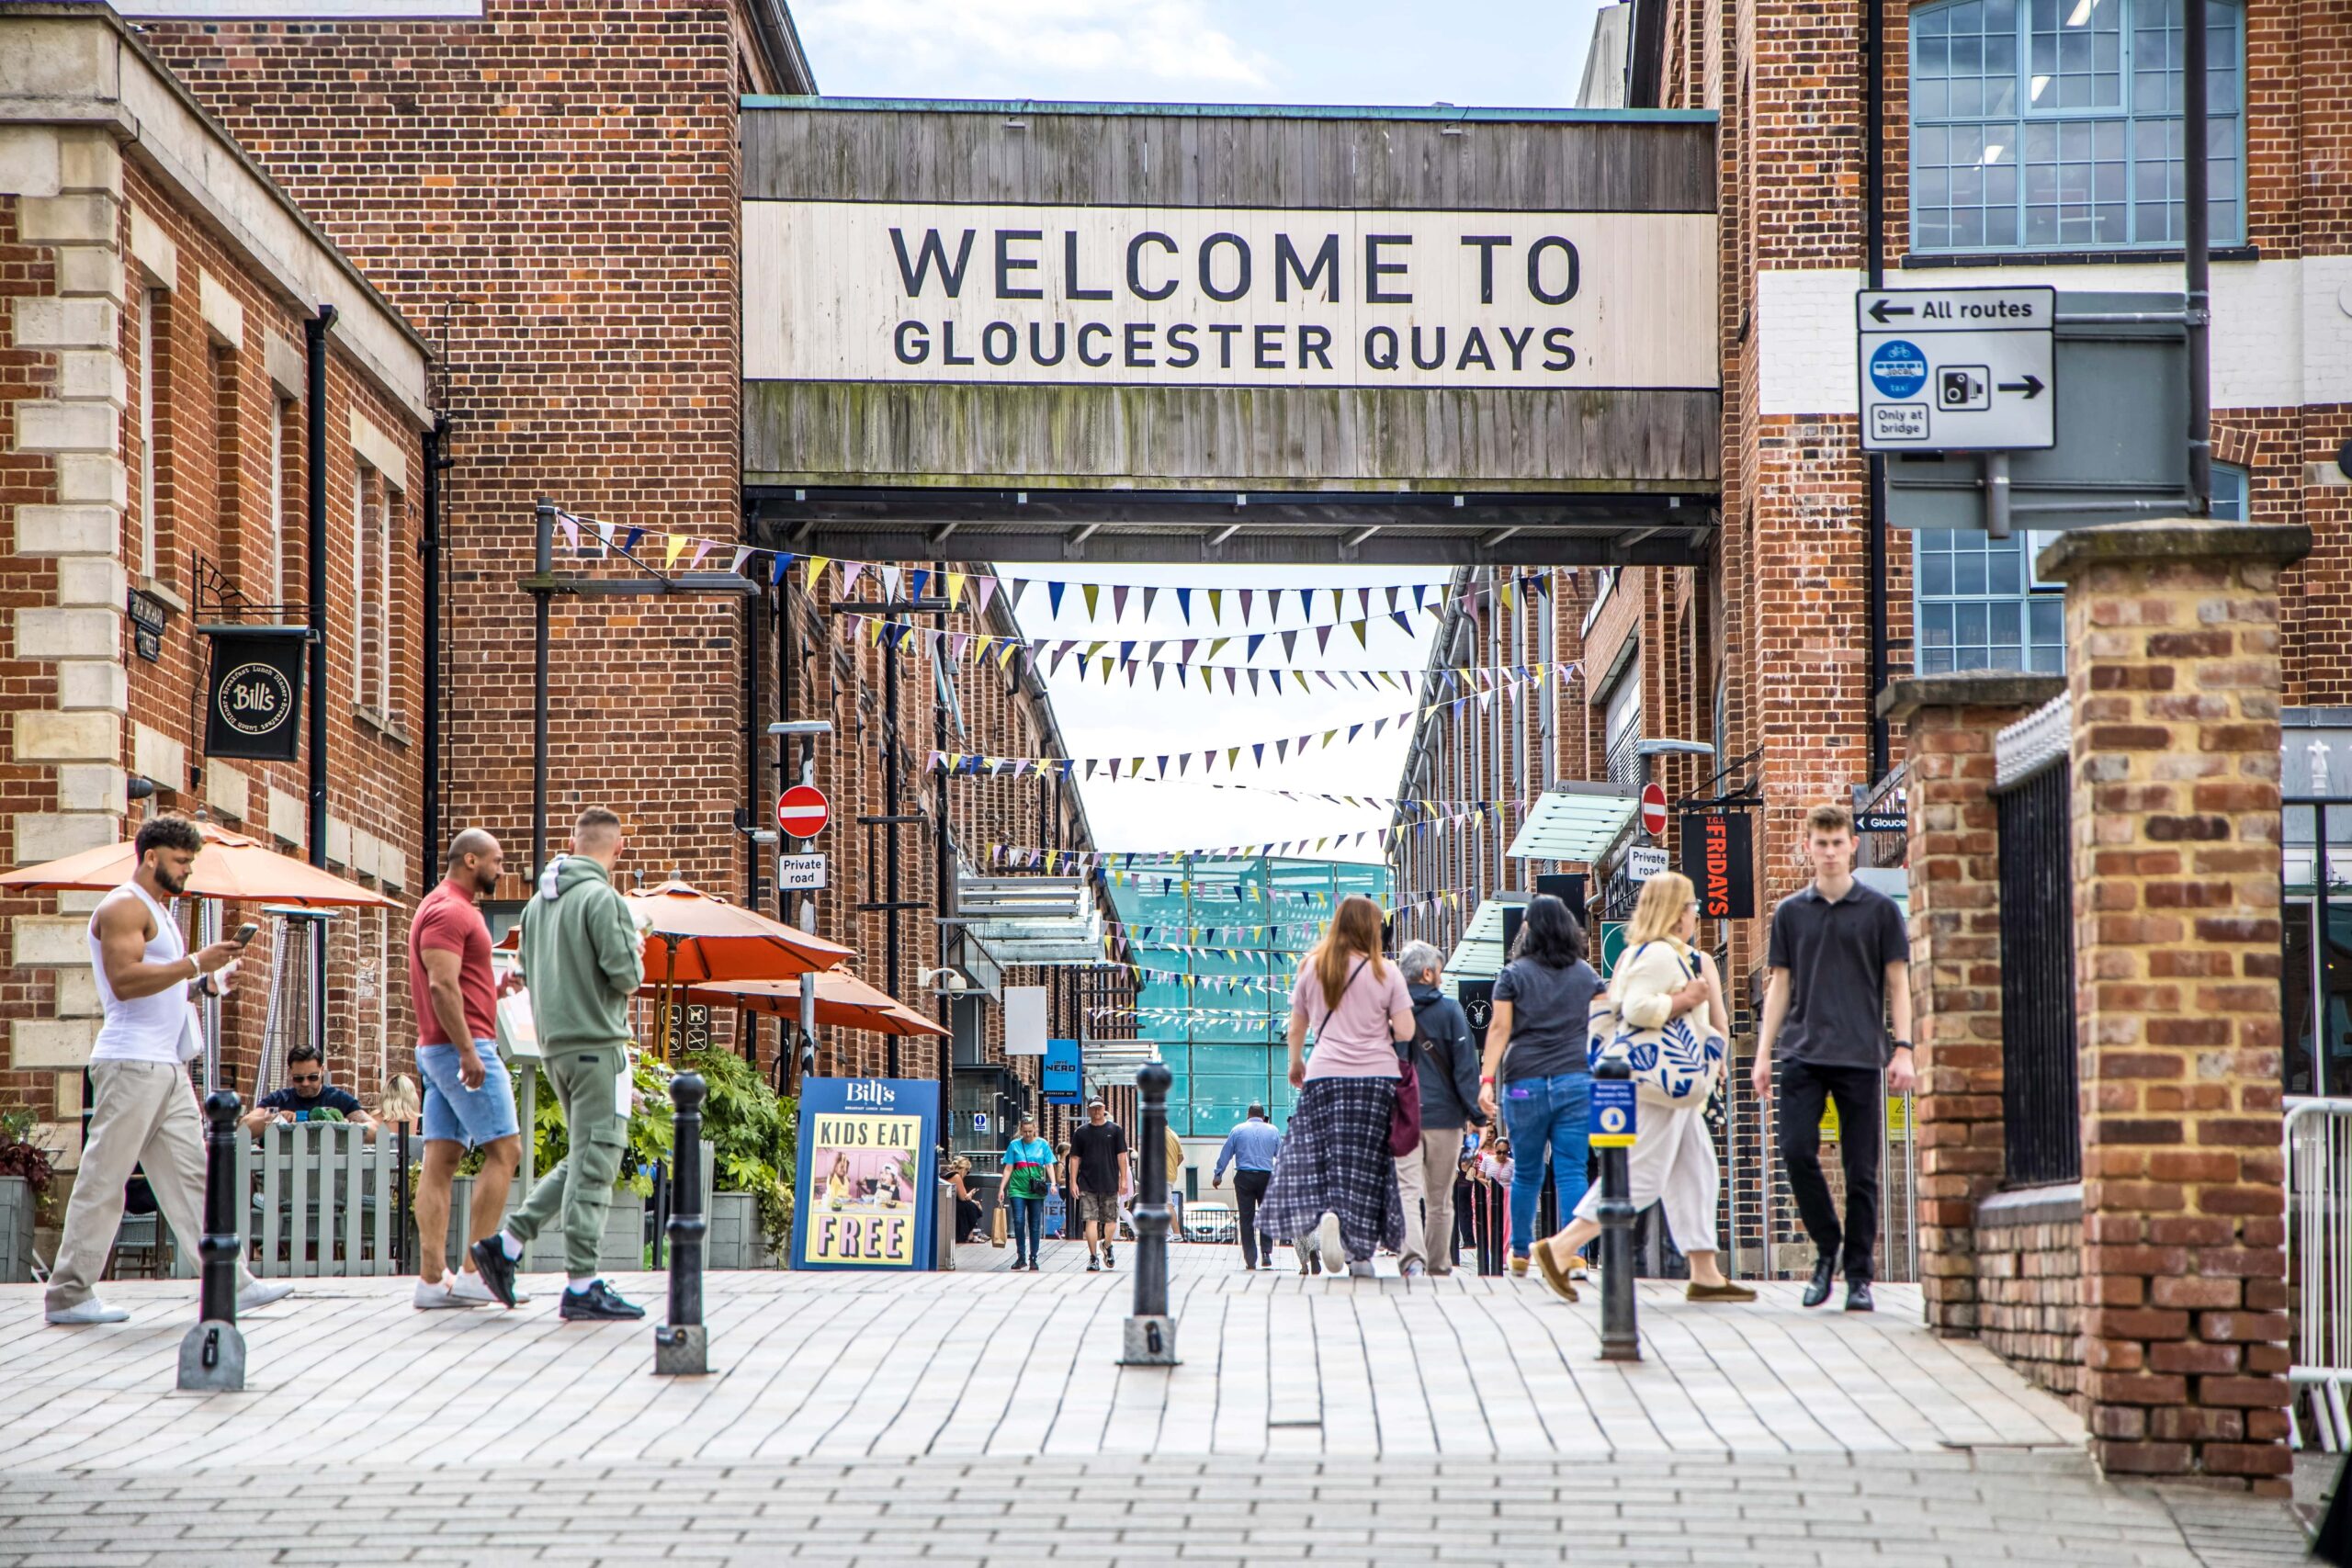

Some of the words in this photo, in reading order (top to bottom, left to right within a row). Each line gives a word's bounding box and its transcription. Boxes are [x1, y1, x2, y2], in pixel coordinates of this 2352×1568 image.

[888, 228, 1413, 304] WELCOME
[1461, 235, 1580, 305] TO
[1922, 300, 1952, 319] All
[1960, 299, 2032, 318] routes
[894, 321, 1333, 369] GLOUCESTER
[1364, 325, 1576, 371] QUAYS
[1878, 410, 1905, 421] Only
[1911, 410, 1923, 420] at
[1881, 423, 1920, 434] bridge
[222, 668, 250, 694] Breakfast
[253, 666, 273, 675] Lunch
[274, 674, 288, 697] Dinner
[232, 682, 275, 711] Bill's
[784, 859, 821, 870] Private
[1633, 851, 1666, 864] Private
[790, 872, 814, 883] road
[1639, 866, 1660, 875] road
[846, 1079, 895, 1105] Bill's
[820, 1122, 868, 1145] KIDS
[876, 1123, 912, 1146] EAT
[817, 1215, 905, 1259] FREE
